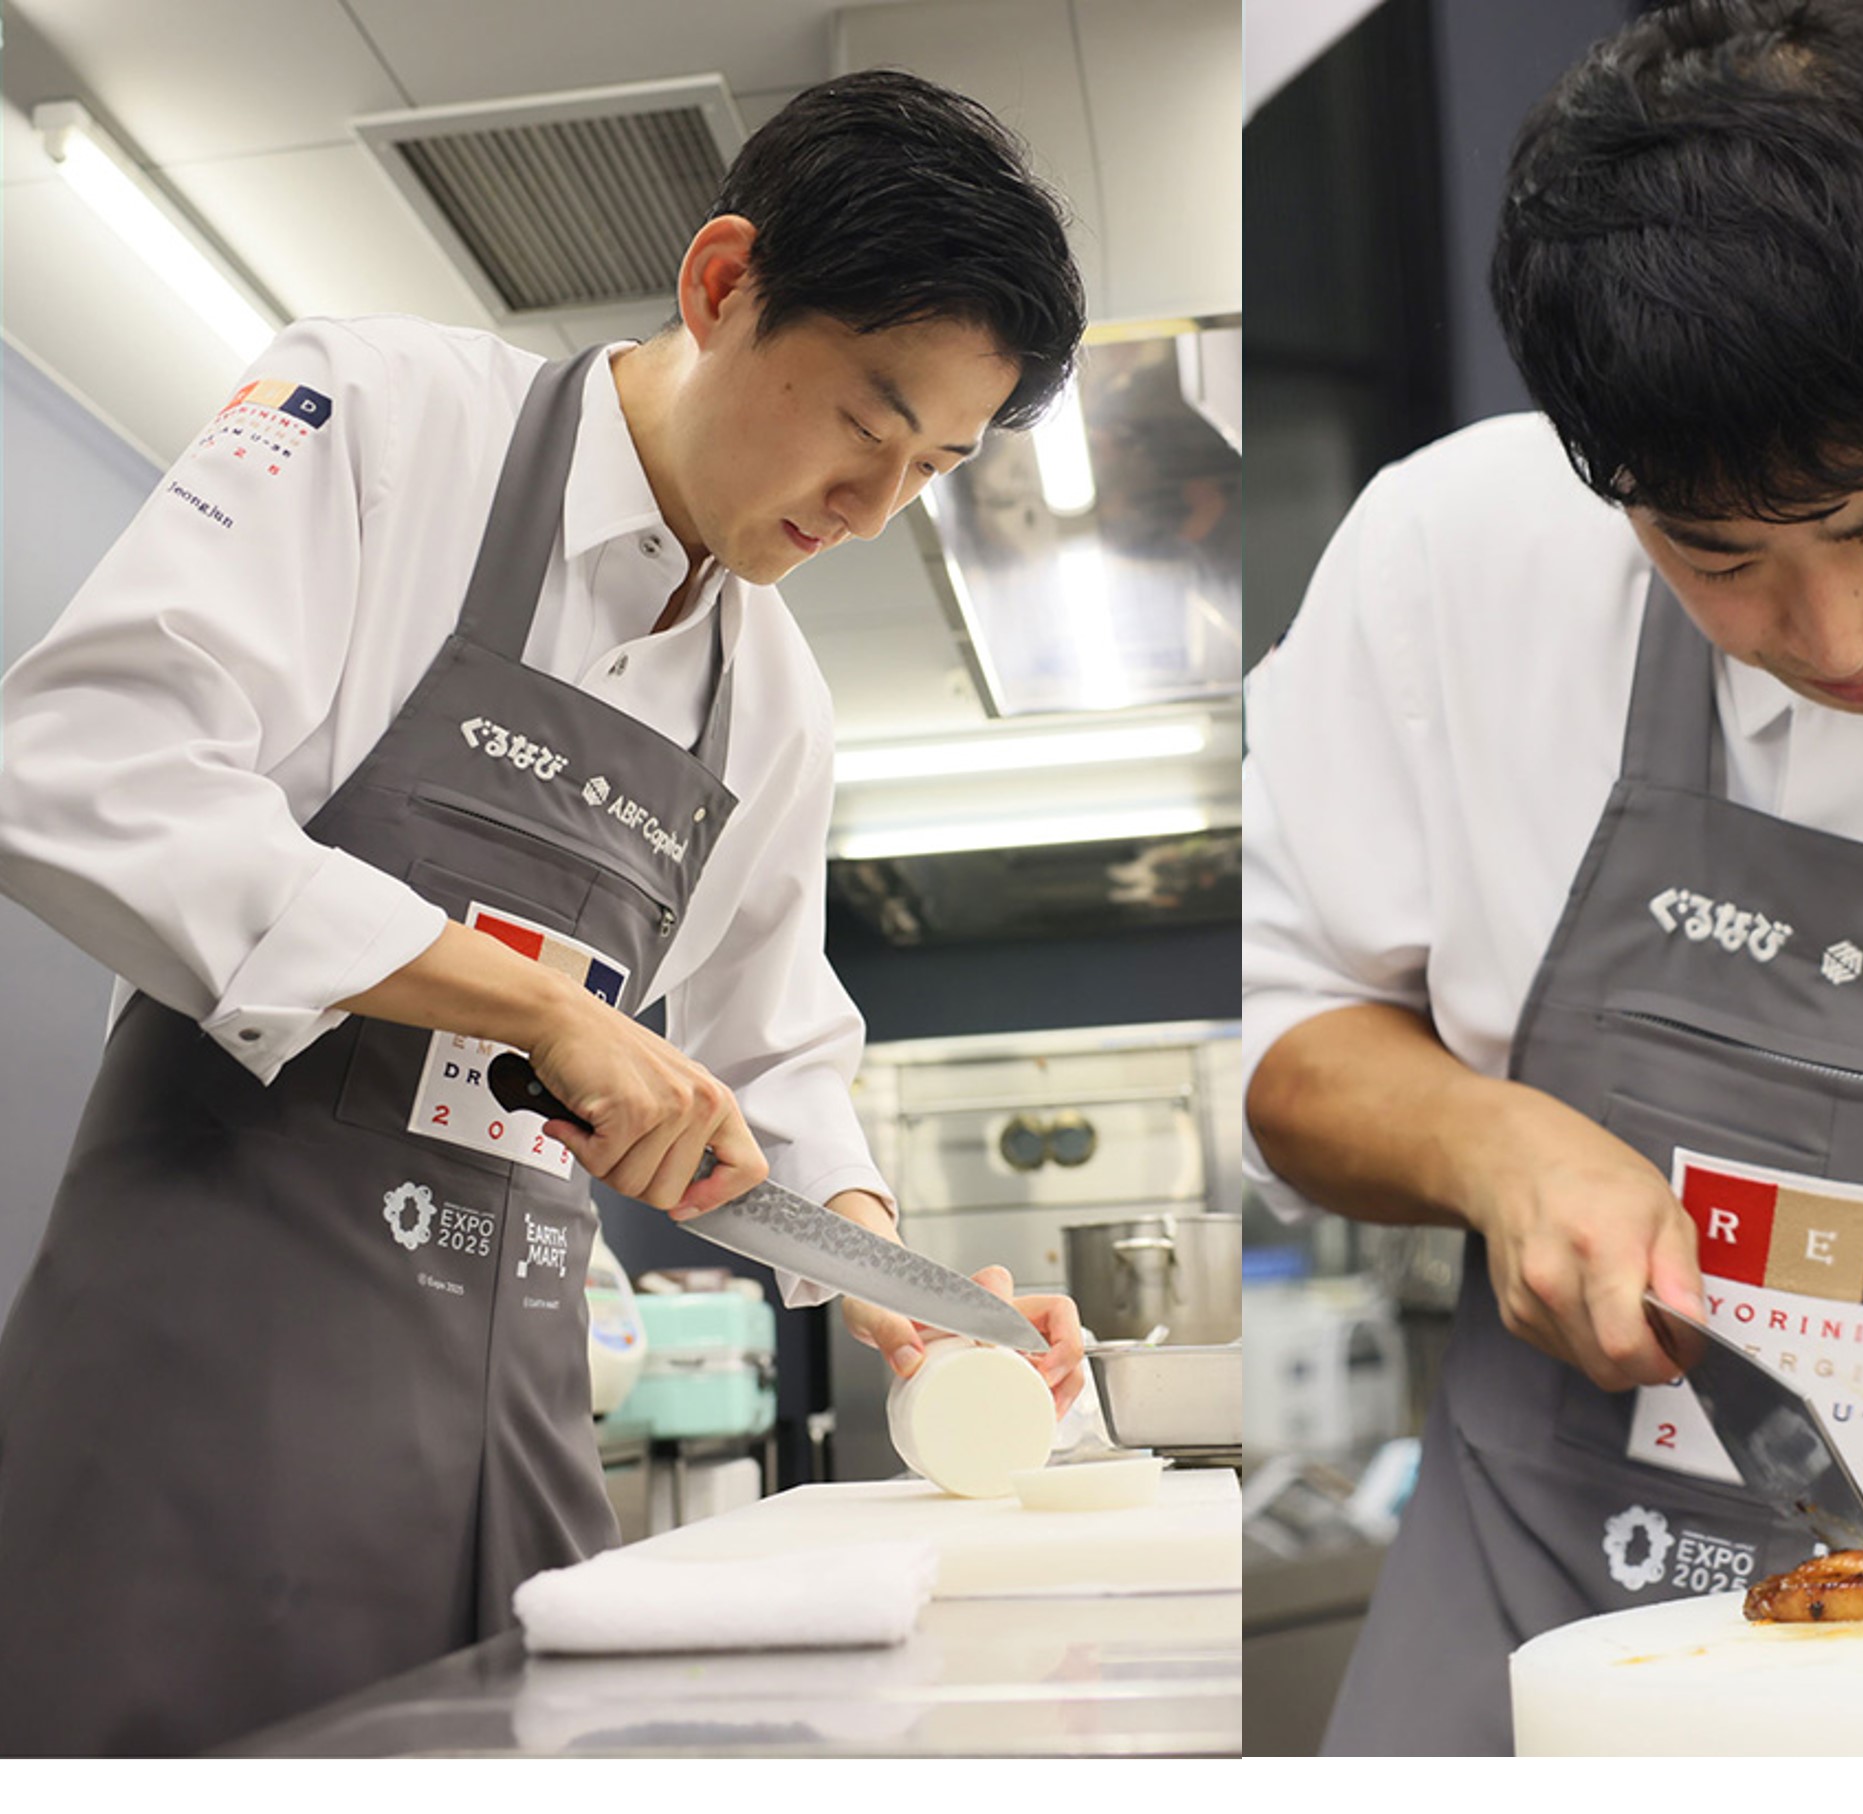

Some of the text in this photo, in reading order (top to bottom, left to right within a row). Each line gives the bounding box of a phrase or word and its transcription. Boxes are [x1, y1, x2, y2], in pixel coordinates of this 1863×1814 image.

[460, 717, 569, 781] ぐるなび
[607, 795, 688, 864] ABF Capital
[1648, 888, 1794, 963] ぐるなび
[440, 1209, 495, 1238] EXPO
[526, 1221, 568, 1248] EARTH
[437, 1228, 491, 1256] 2025
[526, 1244, 568, 1268] MART
[1676, 1537, 1754, 1576] EXPO
